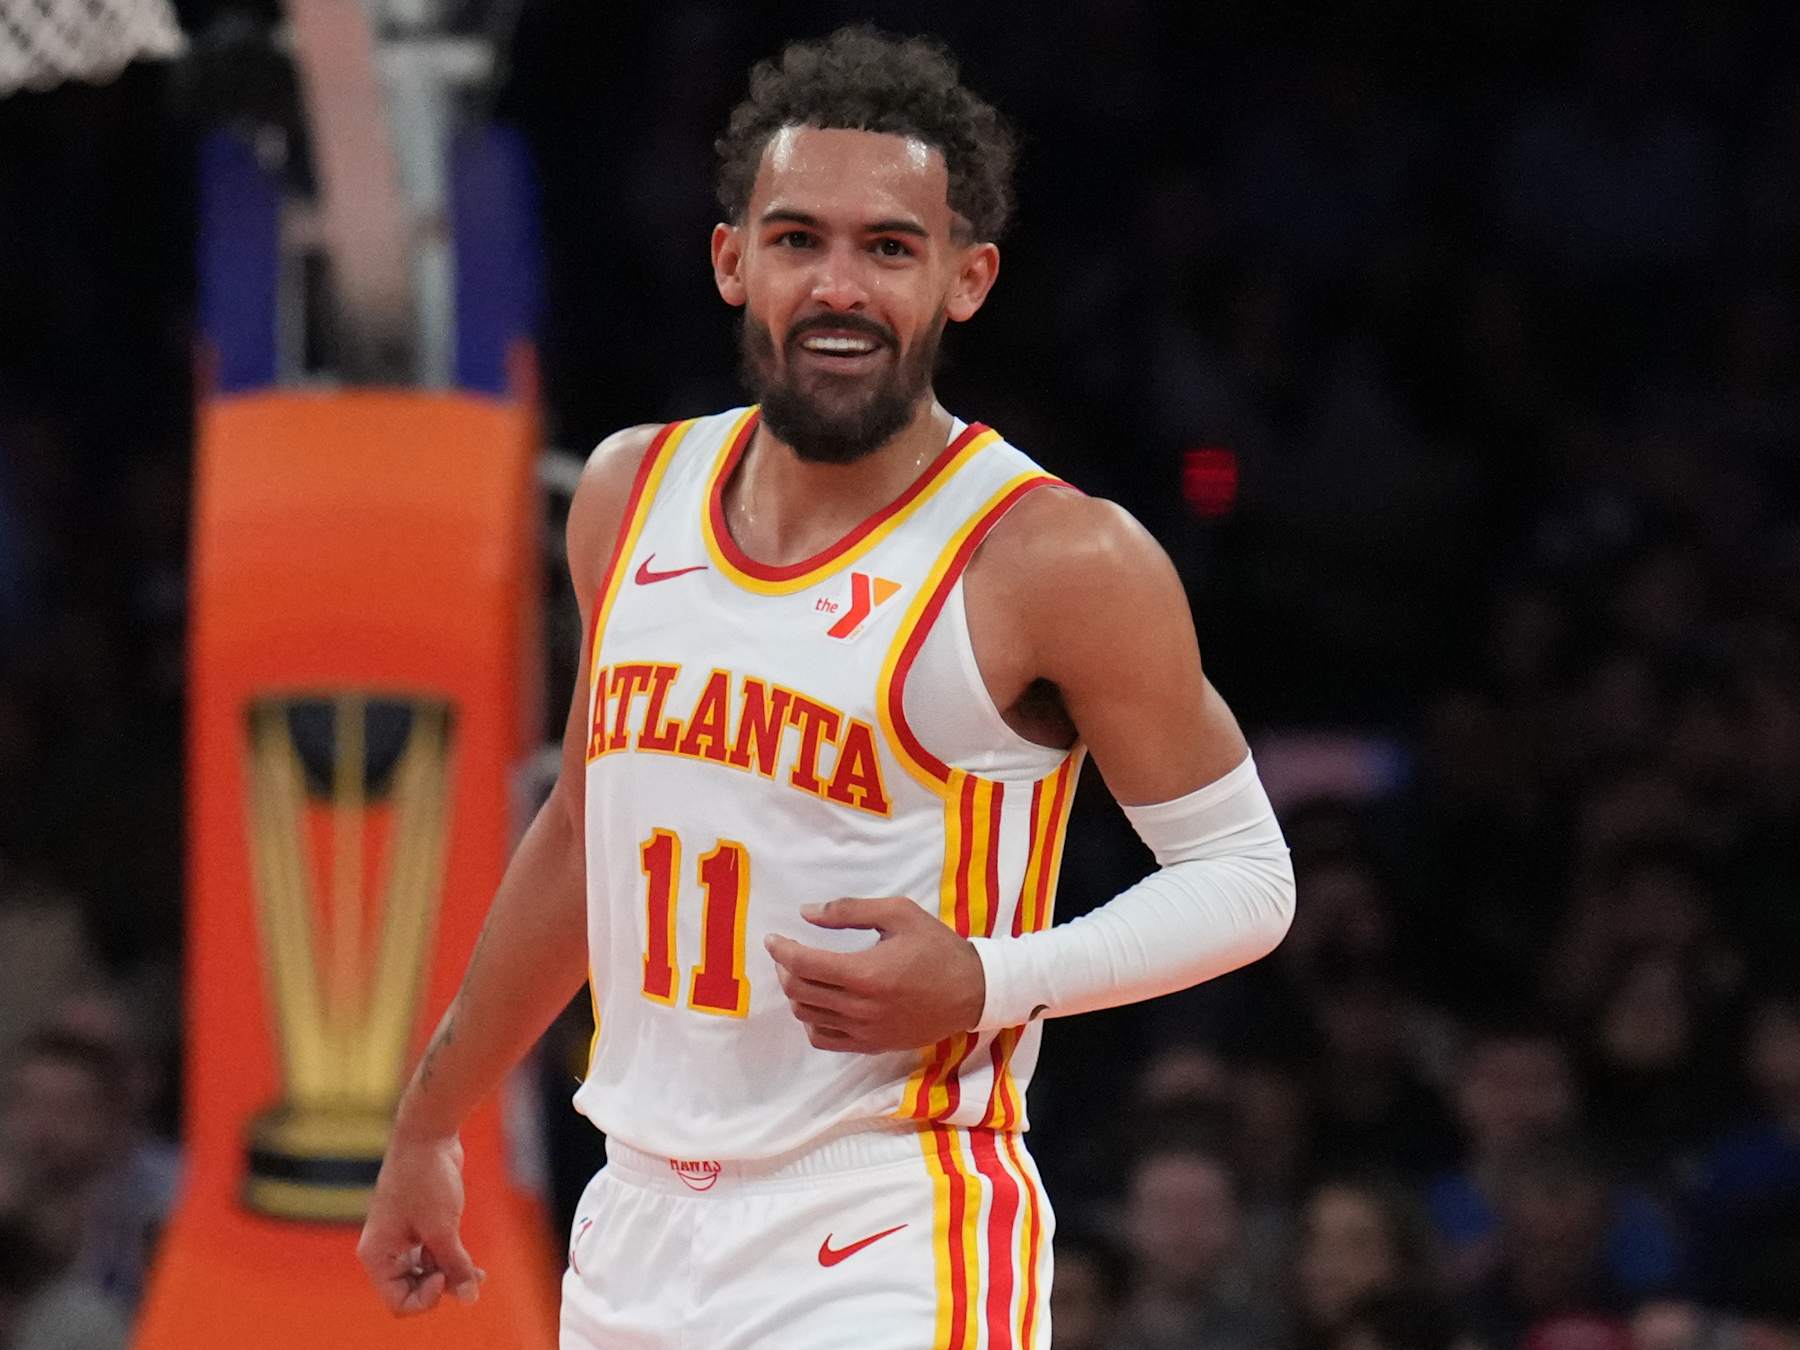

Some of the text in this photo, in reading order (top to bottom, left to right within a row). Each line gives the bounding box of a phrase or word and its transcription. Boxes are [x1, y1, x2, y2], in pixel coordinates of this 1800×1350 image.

[815, 597, 839, 614] the
[586, 660, 893, 818] ATLANTA
[639, 826, 752, 1019] 11
